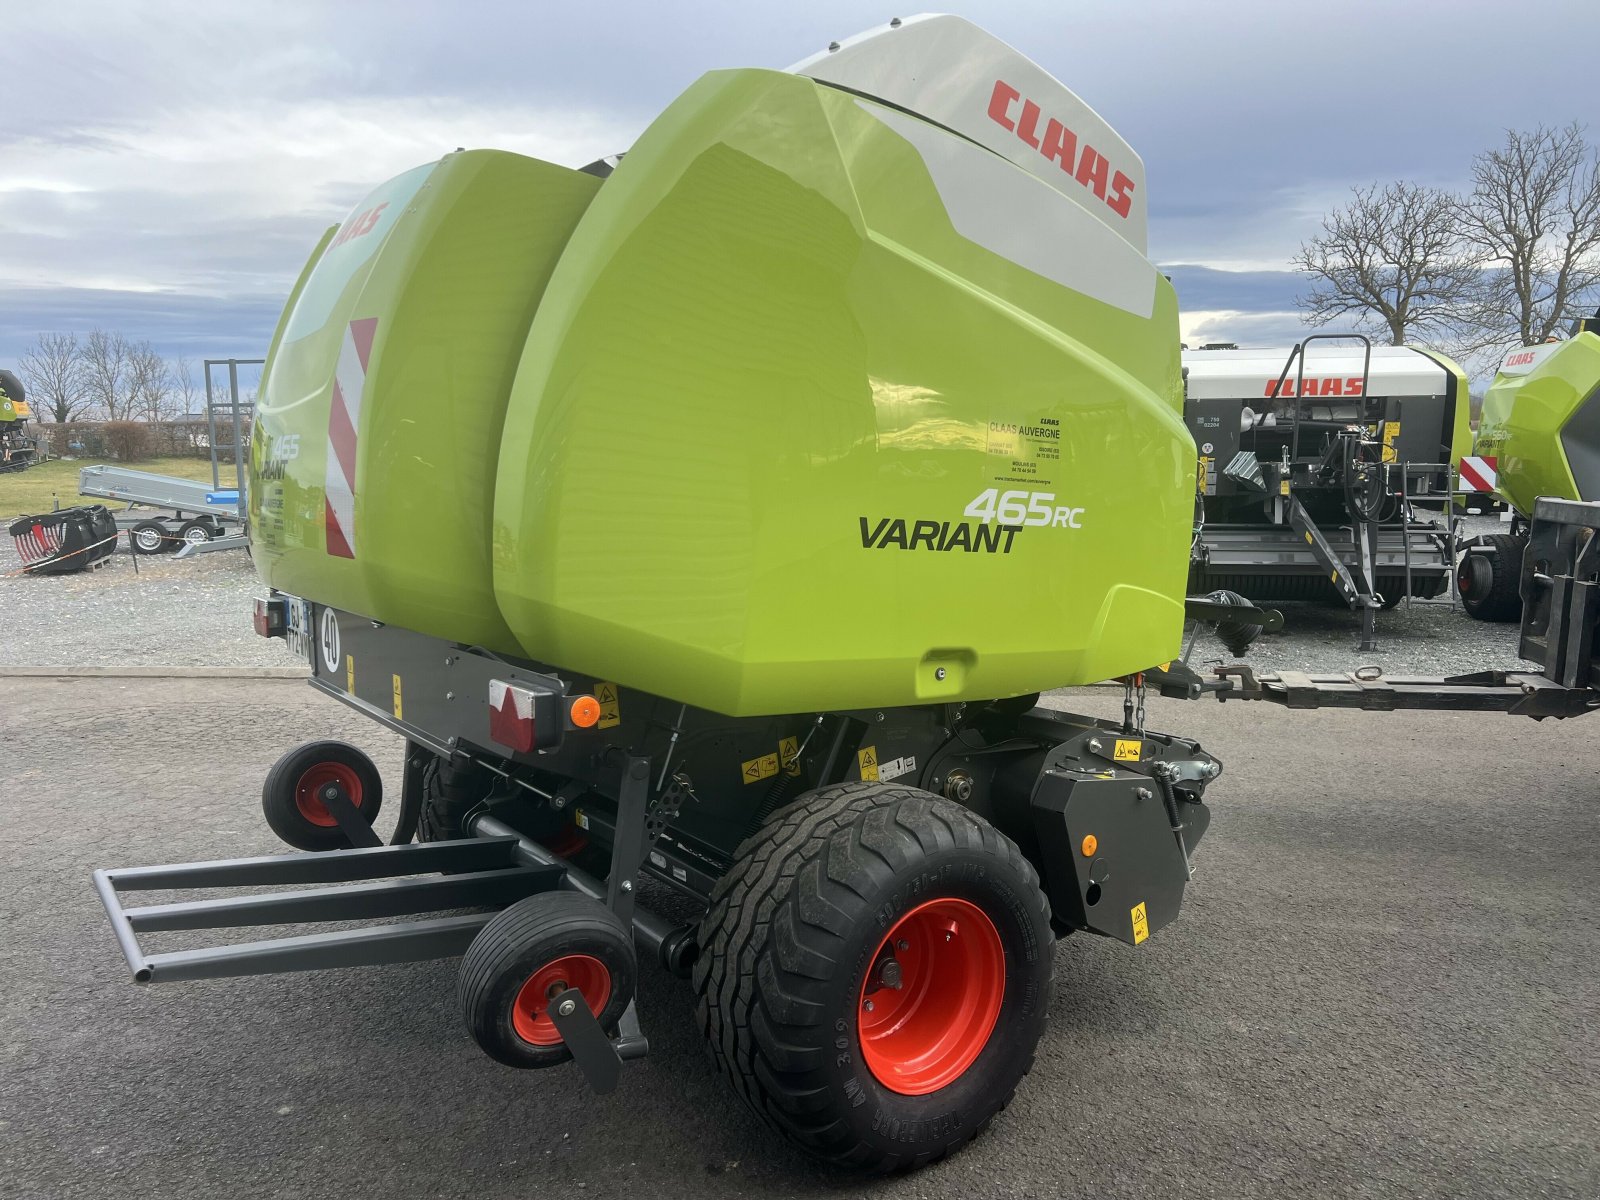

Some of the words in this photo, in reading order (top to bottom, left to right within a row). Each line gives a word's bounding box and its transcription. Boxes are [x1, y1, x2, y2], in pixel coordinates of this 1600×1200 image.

[988, 80, 1135, 219] CLAAS
[1506, 351, 1535, 367] CLAAS
[1264, 378, 1365, 396] CLAAS
[989, 422, 1017, 434] CLAAS
[1018, 425, 1060, 440] AUVERGNE
[1040, 418, 1059, 426] CLAAS
[272, 434, 300, 460] 465
[859, 516, 1023, 554] VARIANT
[324, 613, 337, 665] 40
